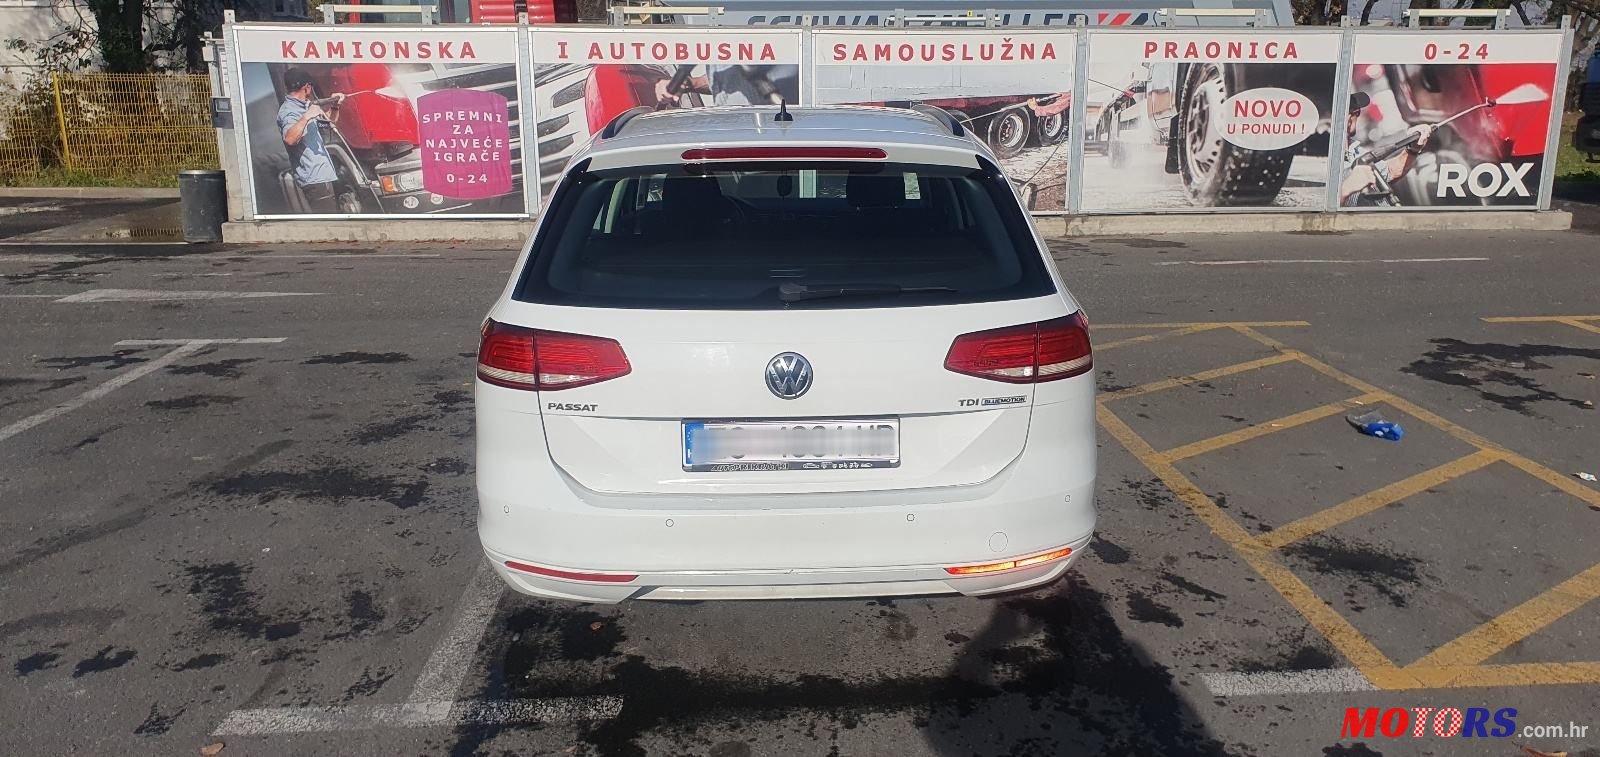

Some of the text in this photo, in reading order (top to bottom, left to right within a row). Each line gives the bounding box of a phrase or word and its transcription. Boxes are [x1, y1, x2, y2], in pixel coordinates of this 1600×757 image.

[281, 40, 477, 59] KAMIONSKA
[558, 41, 776, 60] I AUTOBUSNA
[833, 38, 1057, 61] SAMOUSLUŽNA
[1144, 41, 1298, 59] PRAONICA
[1424, 43, 1489, 60] 0-24
[1234, 100, 1302, 118] NOVO
[422, 110, 503, 124] SPREMNI
[453, 125, 474, 135] ZA
[1227, 124, 1236, 135] U
[1241, 123, 1296, 134] PONUDI
[425, 135, 503, 149] NAJVEĆE
[434, 150, 500, 163] IGRAČE
[446, 174, 488, 184] 0-24
[1436, 162, 1534, 198] ROX
[547, 402, 598, 412] PASSAT
[958, 398, 979, 406] TDI
